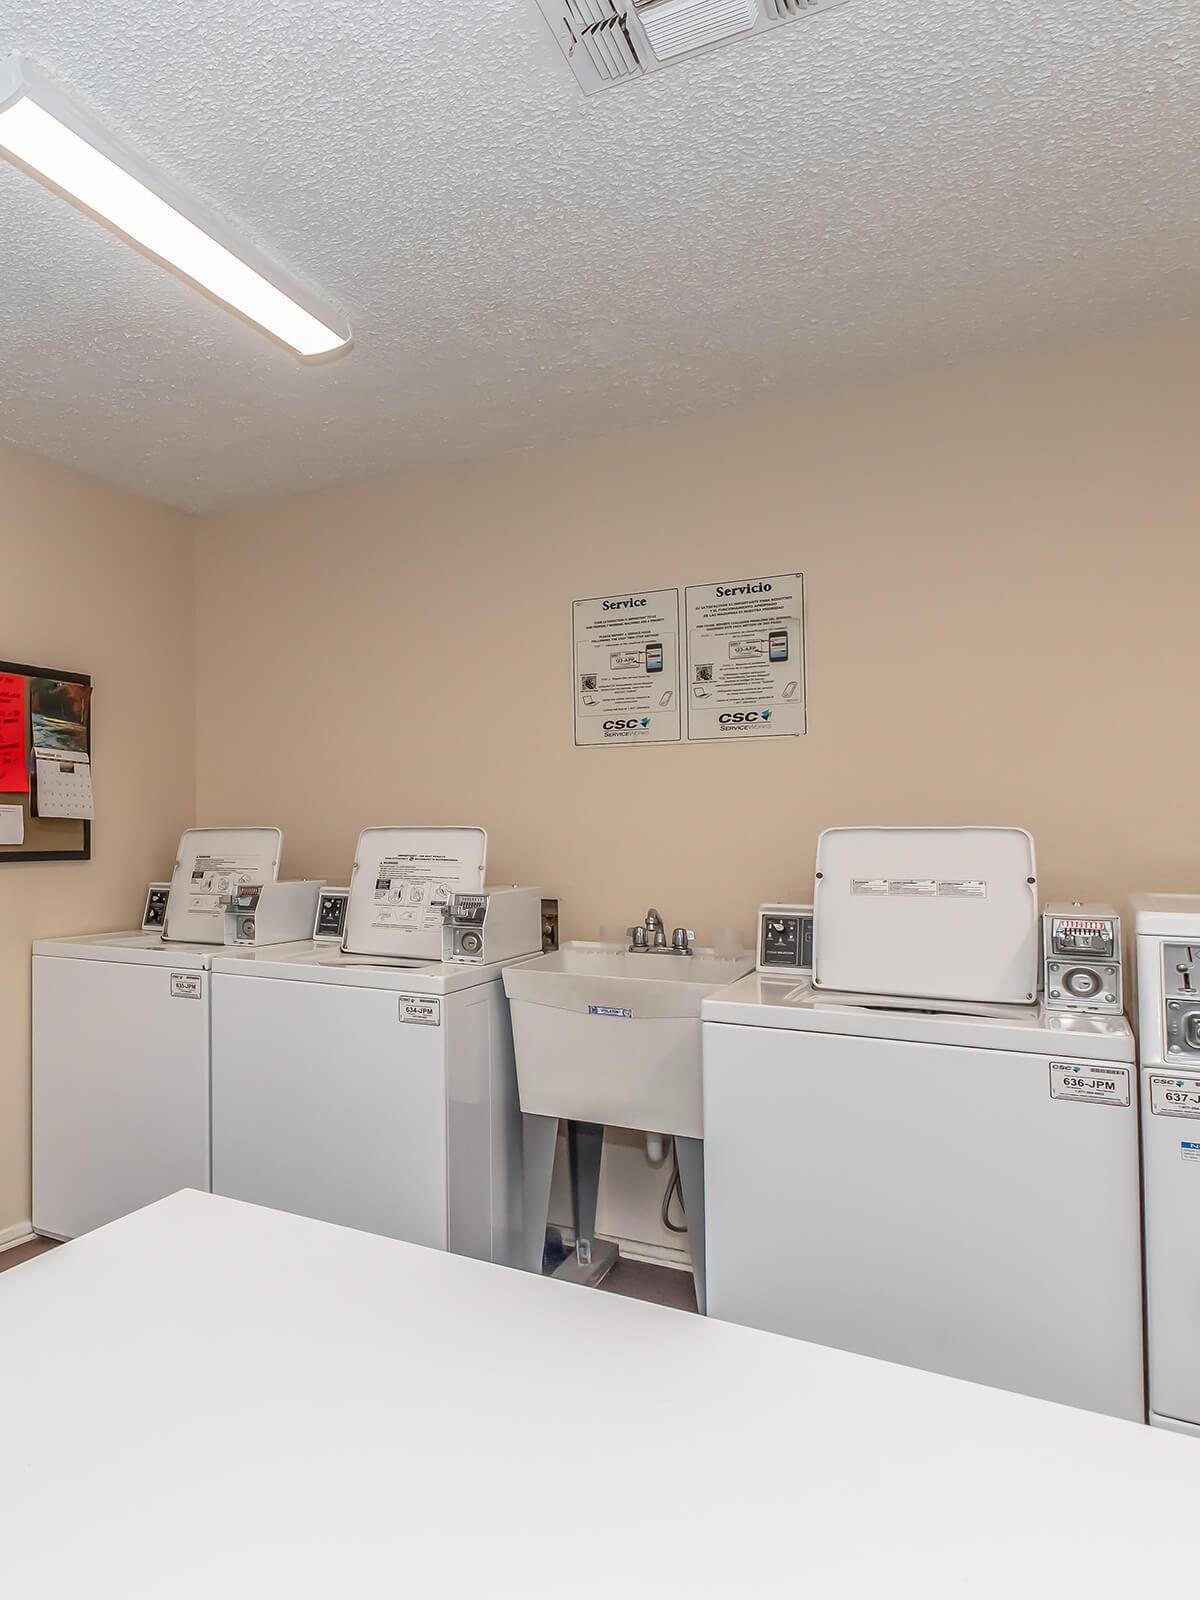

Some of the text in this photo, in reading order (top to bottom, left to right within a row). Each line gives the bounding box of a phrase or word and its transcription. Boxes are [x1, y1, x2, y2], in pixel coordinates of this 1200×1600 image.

[716, 582, 772, 598] Servicio
[602, 598, 647, 611] Service
[603, 718, 638, 730] CSC
[718, 711, 759, 724] CSC
[1063, 1077, 1116, 1091] 636-JPM
